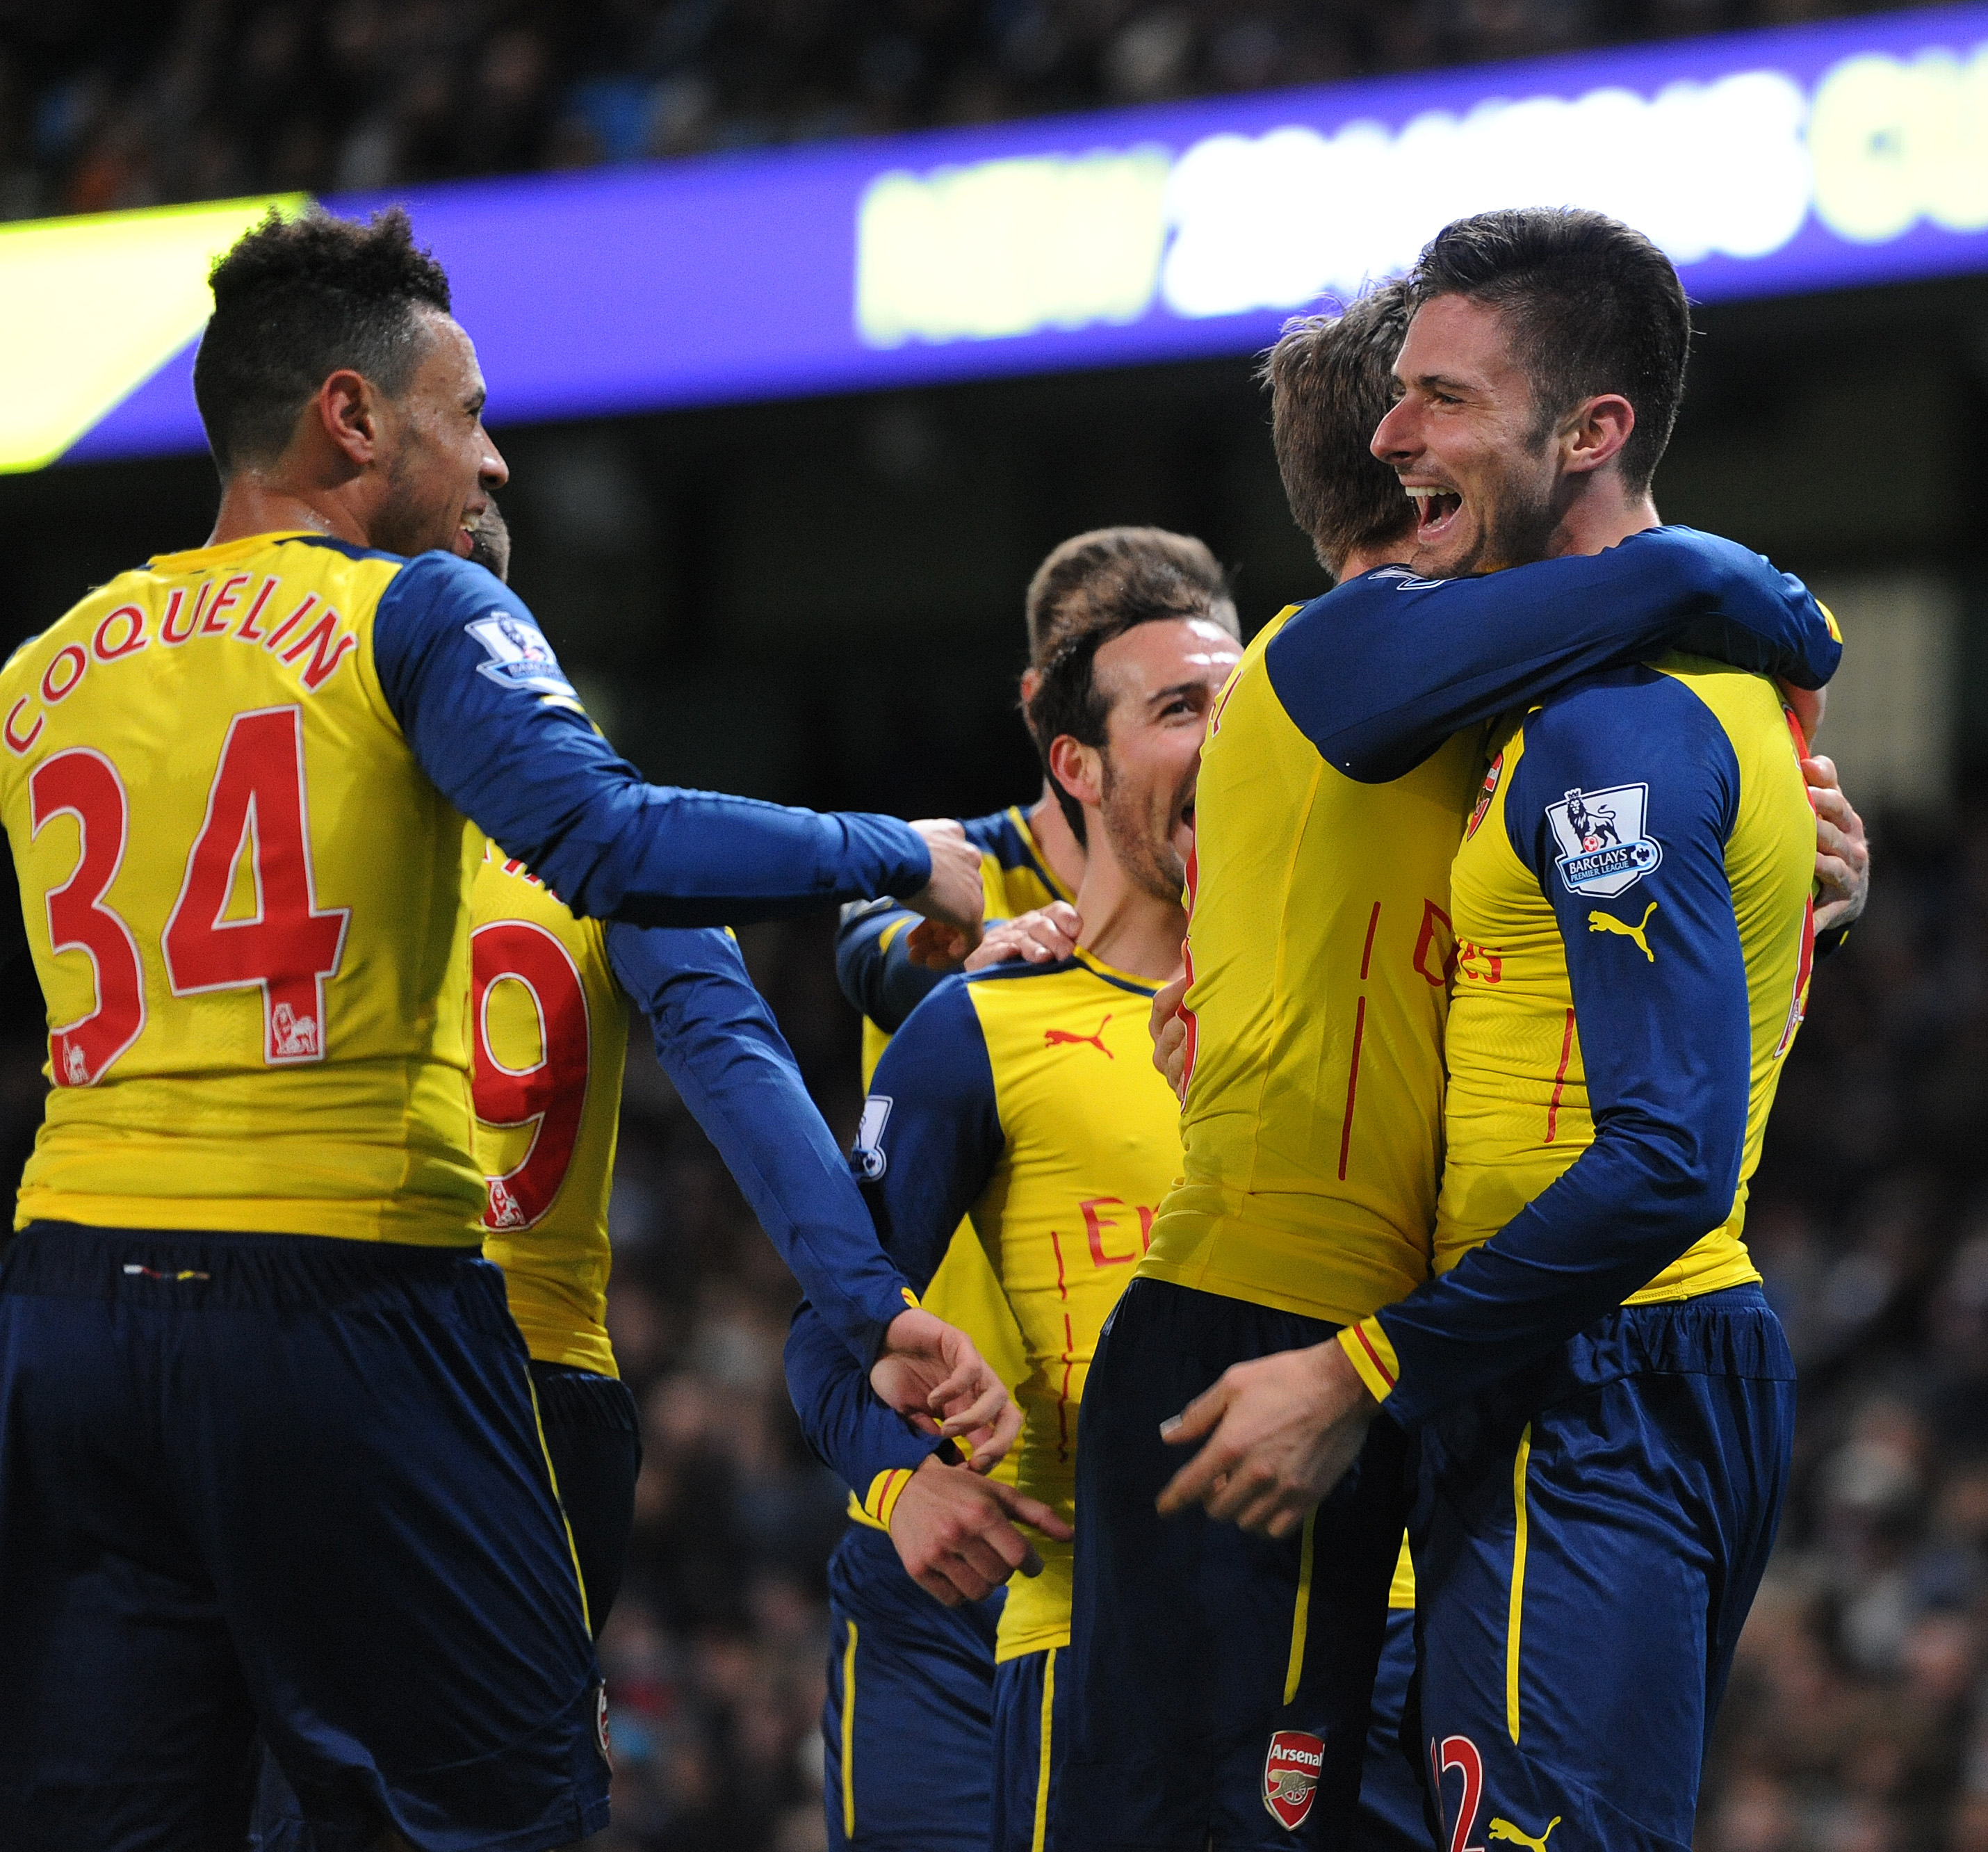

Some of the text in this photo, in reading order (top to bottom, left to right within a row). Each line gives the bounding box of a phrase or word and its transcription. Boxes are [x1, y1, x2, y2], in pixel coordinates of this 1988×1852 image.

[3, 574, 357, 757] COQUELIN
[1569, 849, 1627, 874] BARCLAYS
[1570, 861, 1629, 882] PREMIER LEAGUE
[28, 704, 352, 1087] 34
[1270, 1744, 1323, 1766] Arsenal
